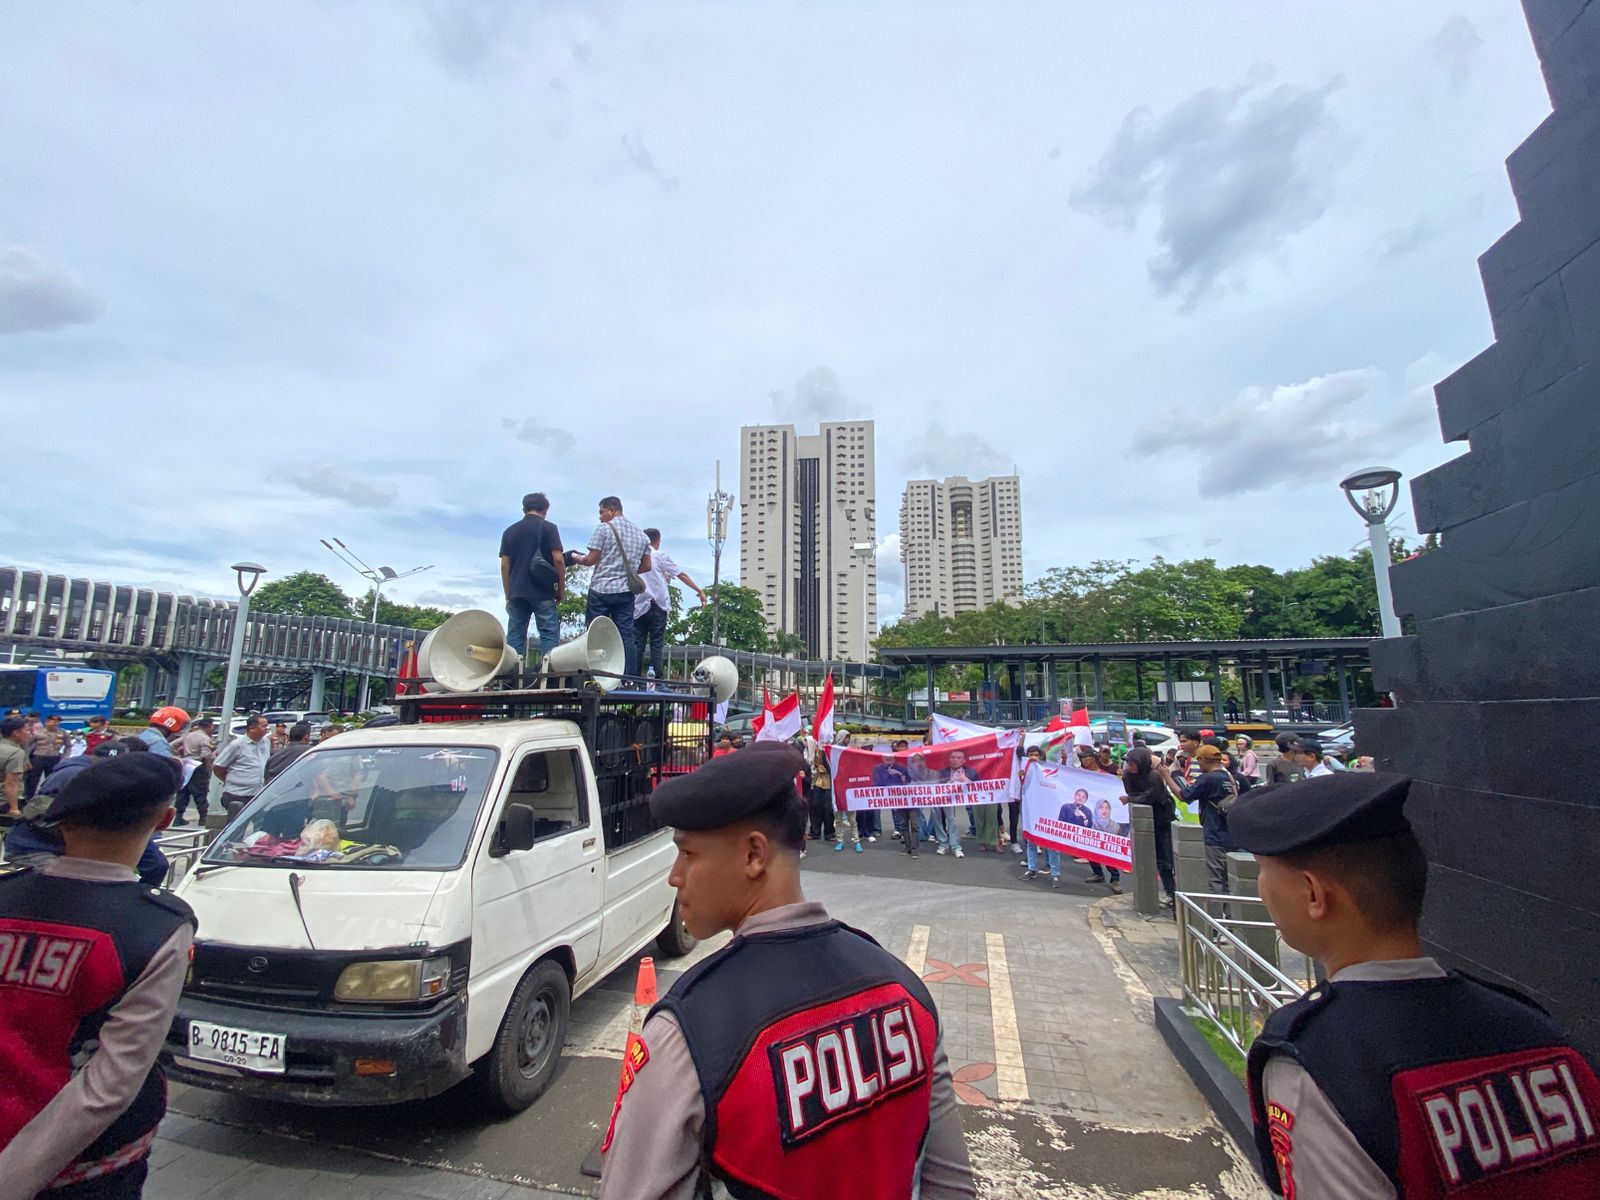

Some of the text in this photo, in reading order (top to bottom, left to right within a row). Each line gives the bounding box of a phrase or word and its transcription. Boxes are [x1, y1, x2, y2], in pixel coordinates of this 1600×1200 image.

[854, 780, 1006, 798] RAKYAT INDONESIA DESAK TANGKAP
[868, 798, 909, 808] PENGHINA
[911, 796, 952, 807] PRESIDEN
[955, 795, 965, 803] RI
[968, 793, 979, 803] KE
[989, 793, 994, 802] 7
[1039, 817, 1080, 834] MASYARAKAT
[1082, 828, 1101, 840] NUSA
[192, 1025, 200, 1046] B
[211, 1029, 249, 1054] 9815
[781, 1003, 924, 1131] POLISI
[1425, 1062, 1594, 1181] POLISI
